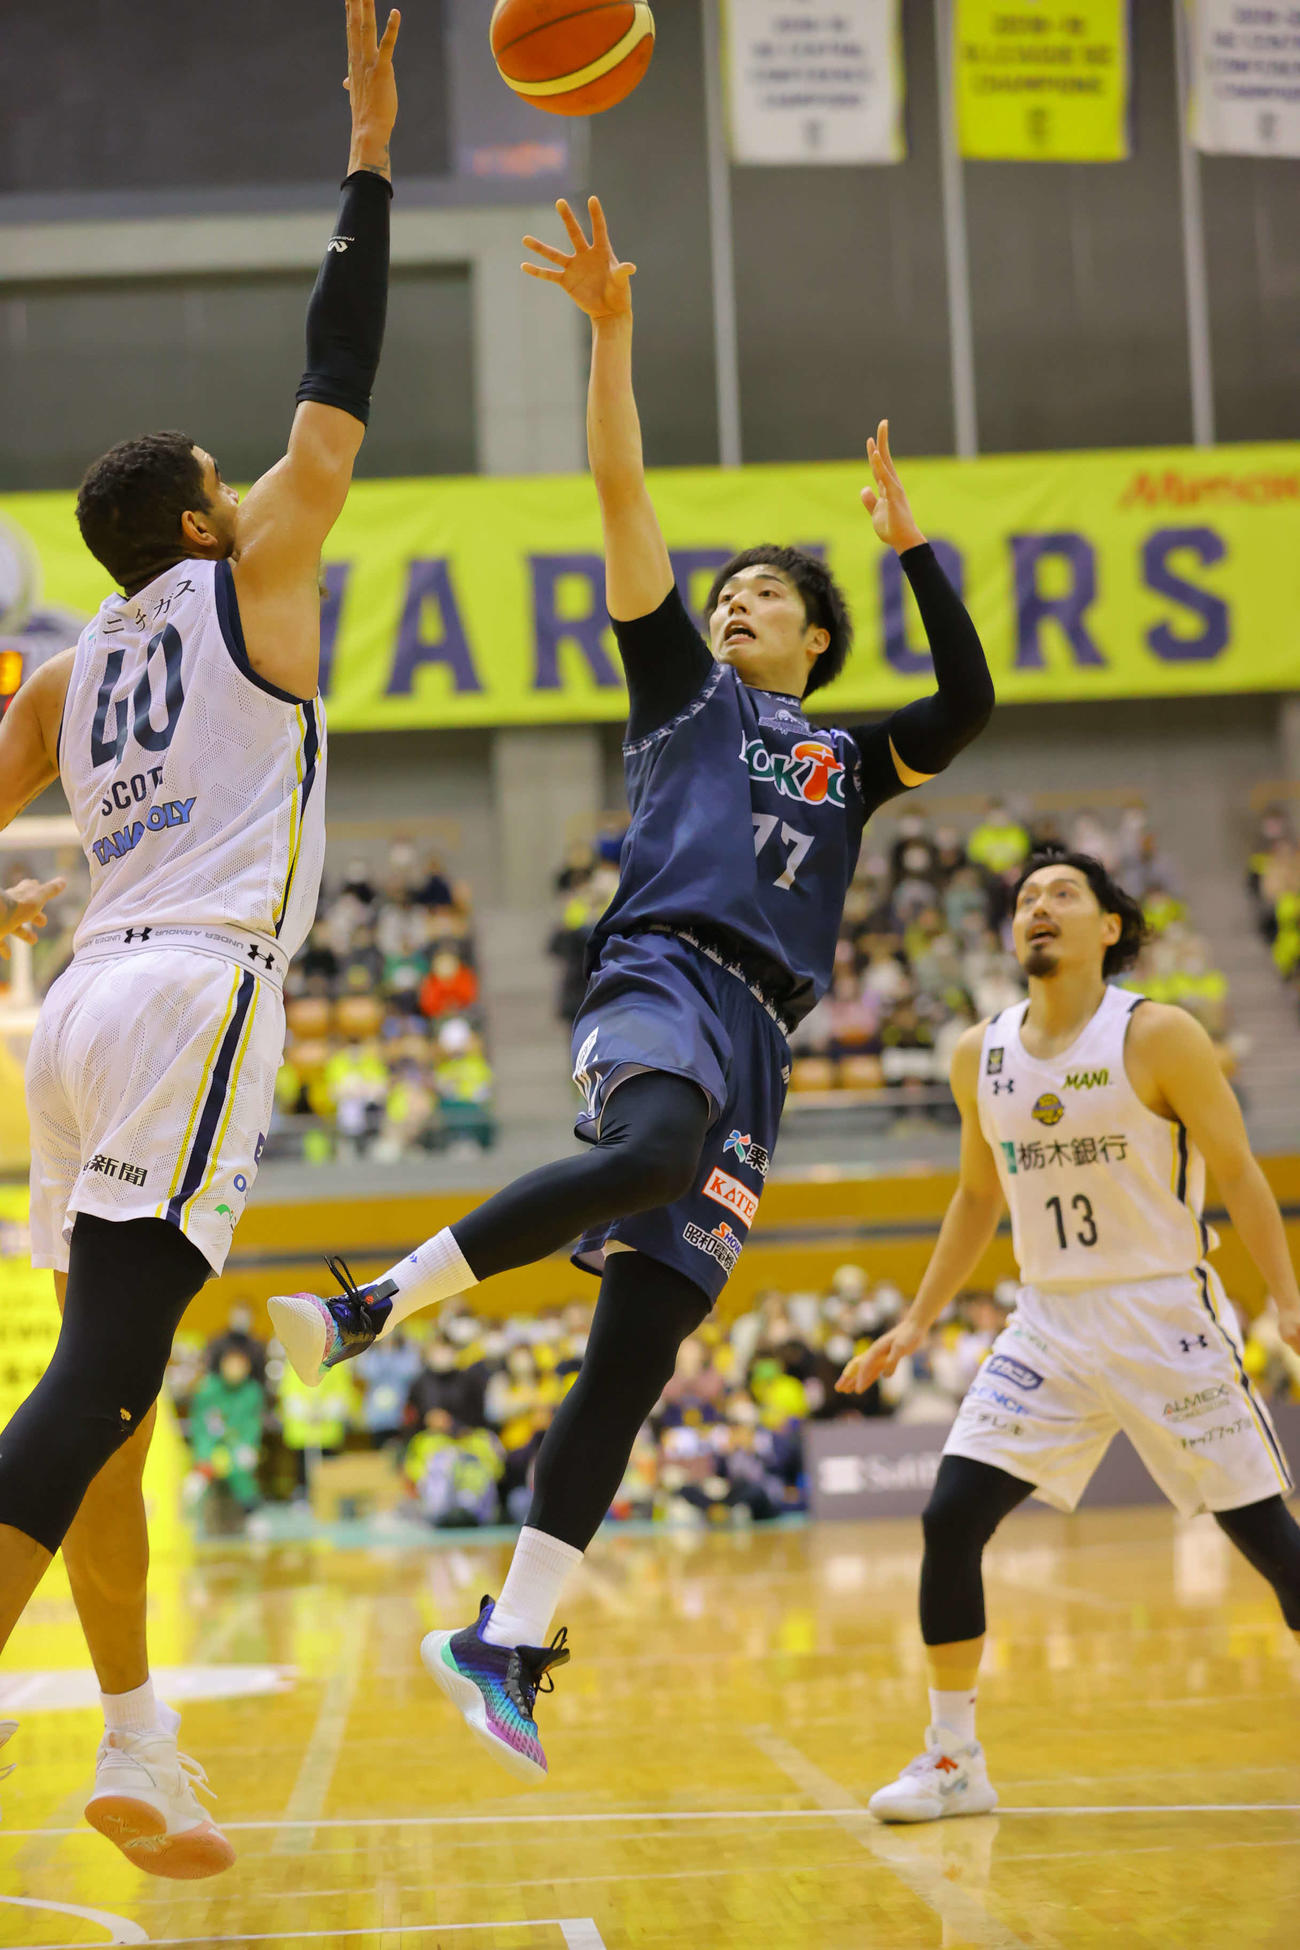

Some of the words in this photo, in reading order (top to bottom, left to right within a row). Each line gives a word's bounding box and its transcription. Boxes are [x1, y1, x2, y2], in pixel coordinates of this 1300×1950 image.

[103, 580, 195, 634] ニチガス
[155, 929, 202, 937] ARMOUR
[205, 932, 244, 949] UNDER
[1061, 1068, 1109, 1090] MANI
[746, 1144, 769, 1176] 栗
[1018, 1135, 1128, 1171] 栃木銀行
[83, 1155, 148, 1187] 新聞
[1045, 1193, 1098, 1249] 13
